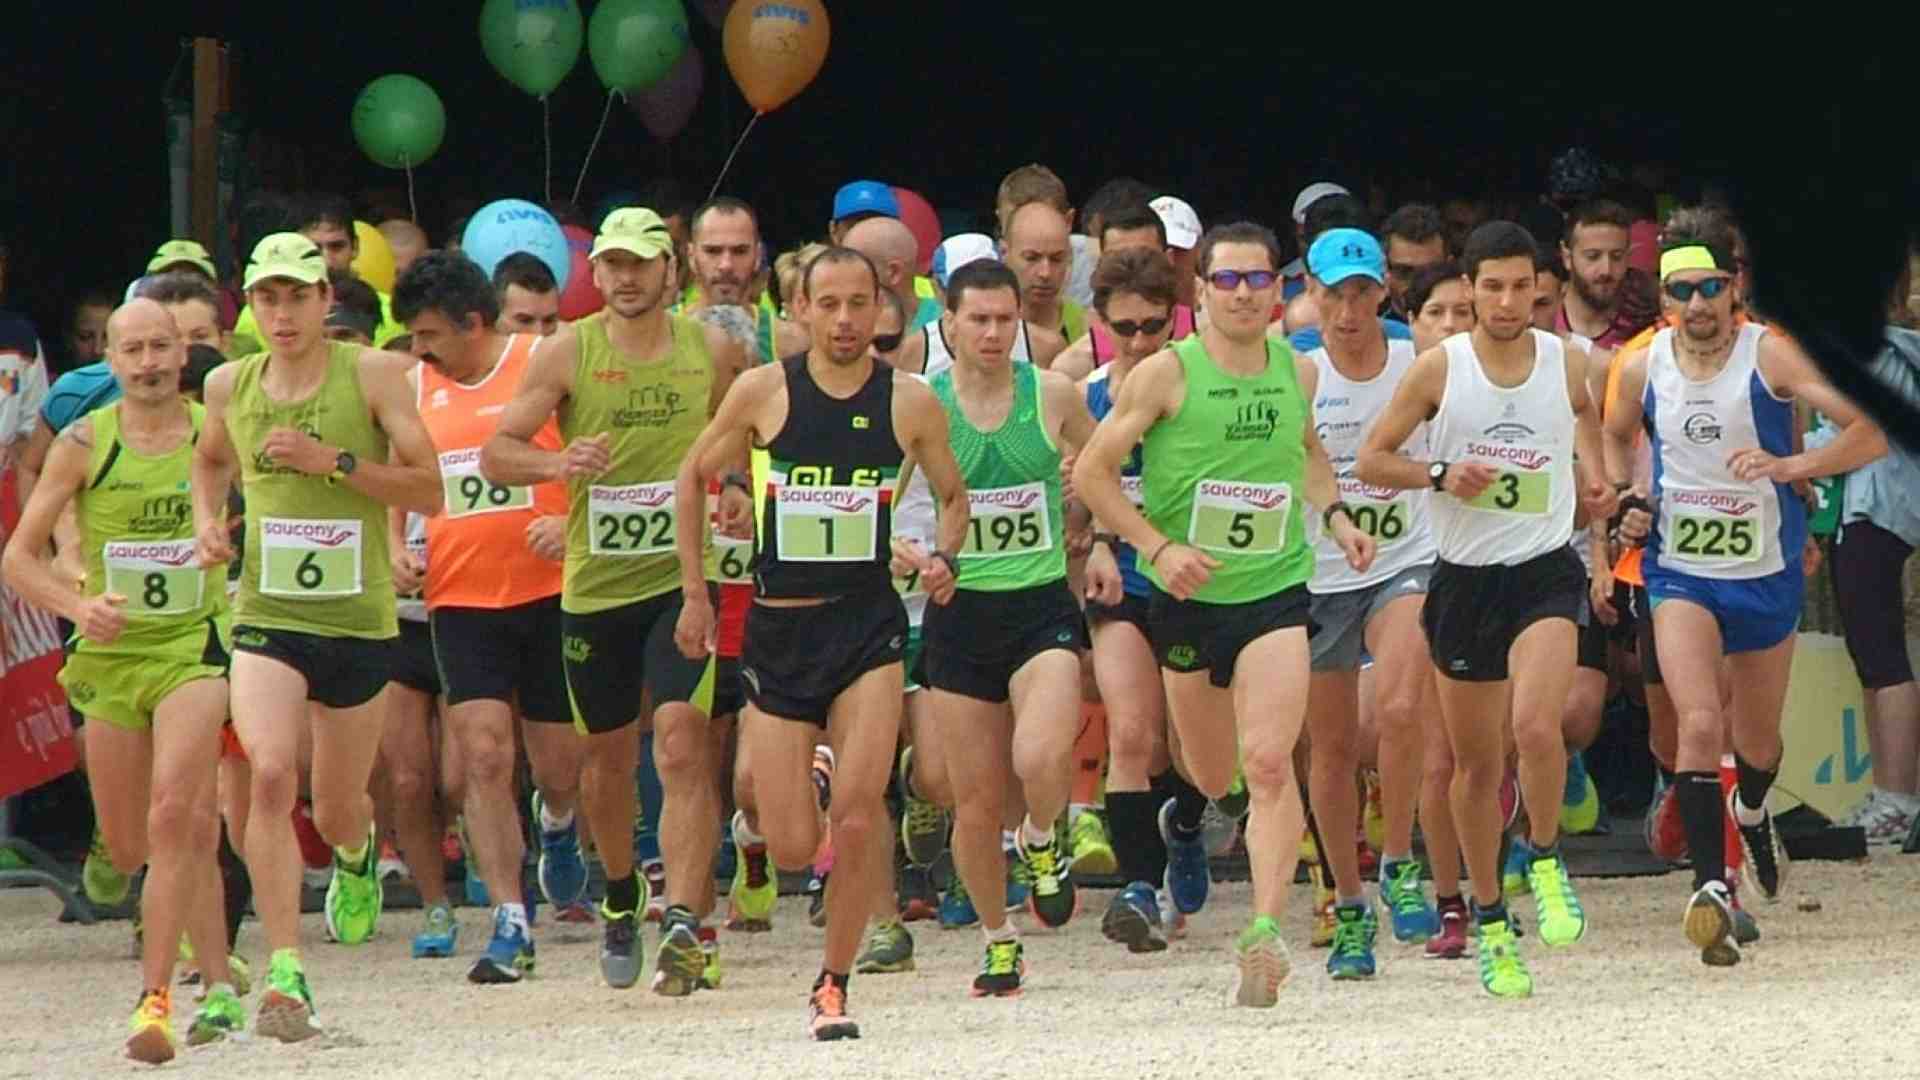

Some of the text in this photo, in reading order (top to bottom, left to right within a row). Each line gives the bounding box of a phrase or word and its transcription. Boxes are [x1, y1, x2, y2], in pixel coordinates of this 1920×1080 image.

[1466, 442, 1537, 461] saucony
[592, 487, 657, 502] saucony
[781, 489, 856, 505] saucony
[1201, 483, 1272, 501] saucony
[1493, 473, 1520, 509] 3
[1672, 491, 1738, 507] saucony
[264, 522, 338, 538] saucony
[599, 511, 674, 550] 292
[818, 517, 834, 555] 1
[969, 512, 1040, 551] 195
[1227, 513, 1254, 548] 5
[1677, 518, 1753, 556] 225
[109, 543, 180, 560] saucony
[720, 546, 752, 579] 6
[295, 551, 324, 590] 6
[143, 572, 169, 609] 8
